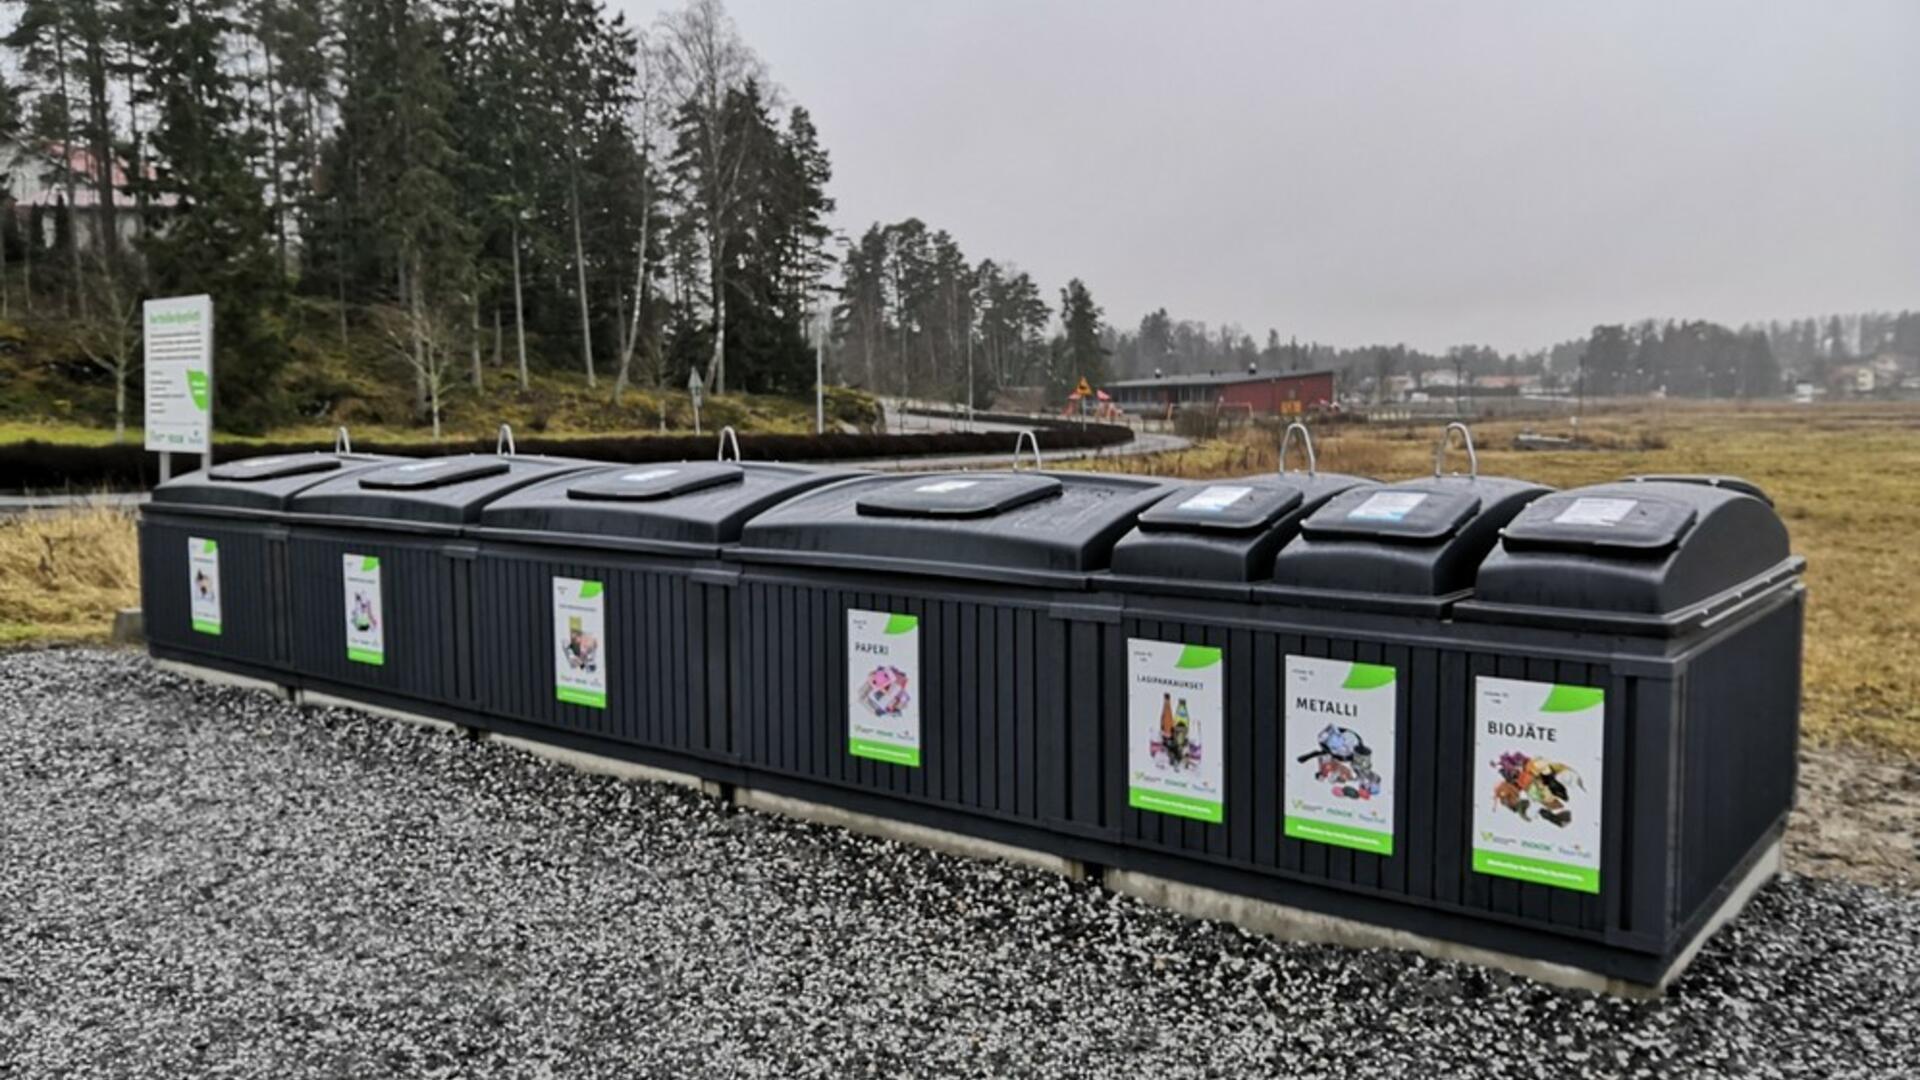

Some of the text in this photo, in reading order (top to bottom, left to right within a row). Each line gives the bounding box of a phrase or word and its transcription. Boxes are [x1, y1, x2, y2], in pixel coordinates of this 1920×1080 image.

[855, 641, 889, 655] PAPERI
[1296, 697, 1358, 717] METALLI
[1488, 720, 1557, 742] BIOJÄTE
